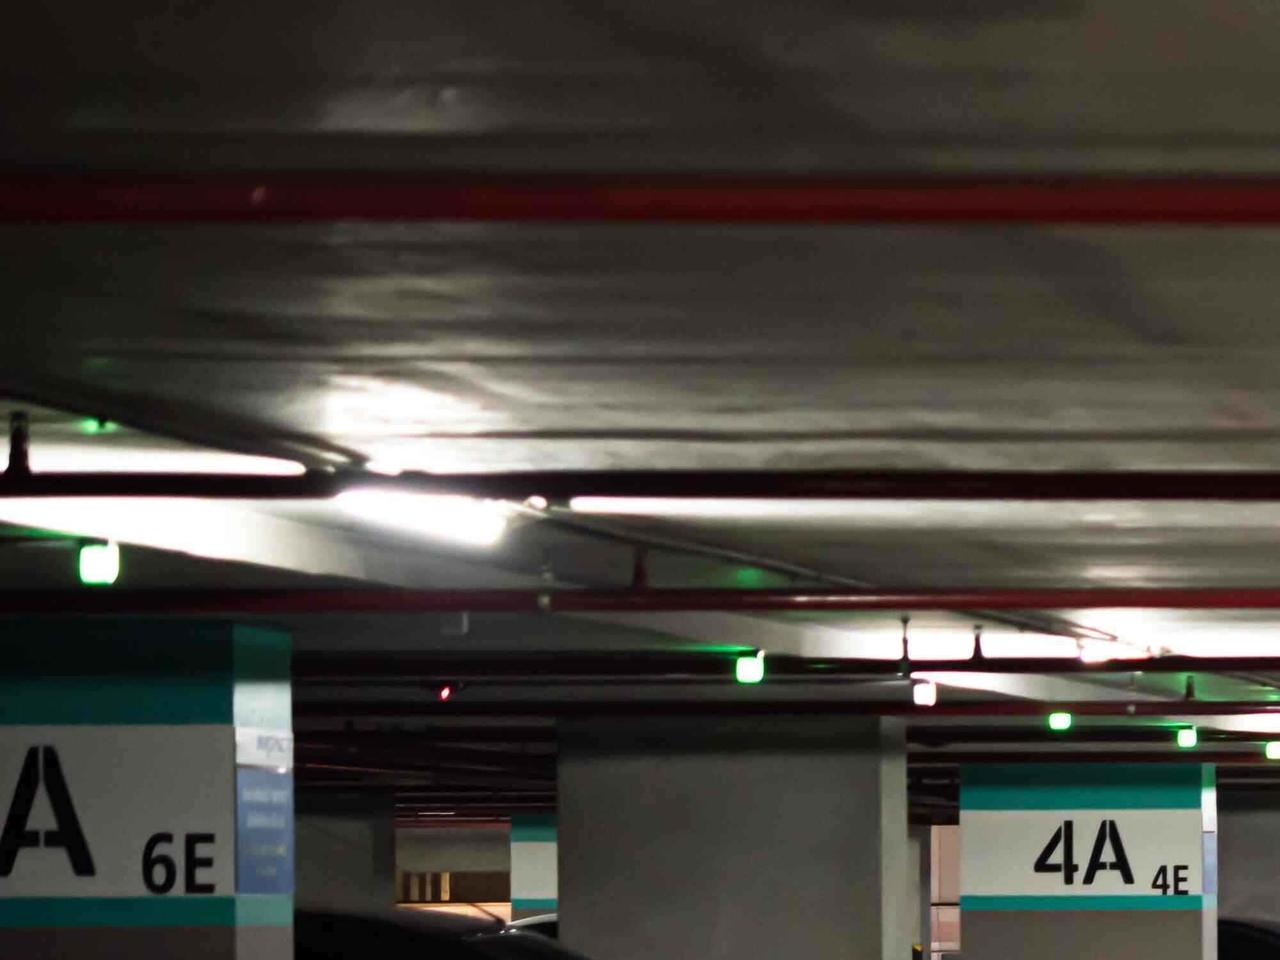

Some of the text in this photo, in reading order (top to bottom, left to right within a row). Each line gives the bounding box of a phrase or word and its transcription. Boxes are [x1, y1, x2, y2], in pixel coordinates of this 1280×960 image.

[142, 832, 216, 895] 6E
[1034, 820, 1189, 895] 4A 4E
